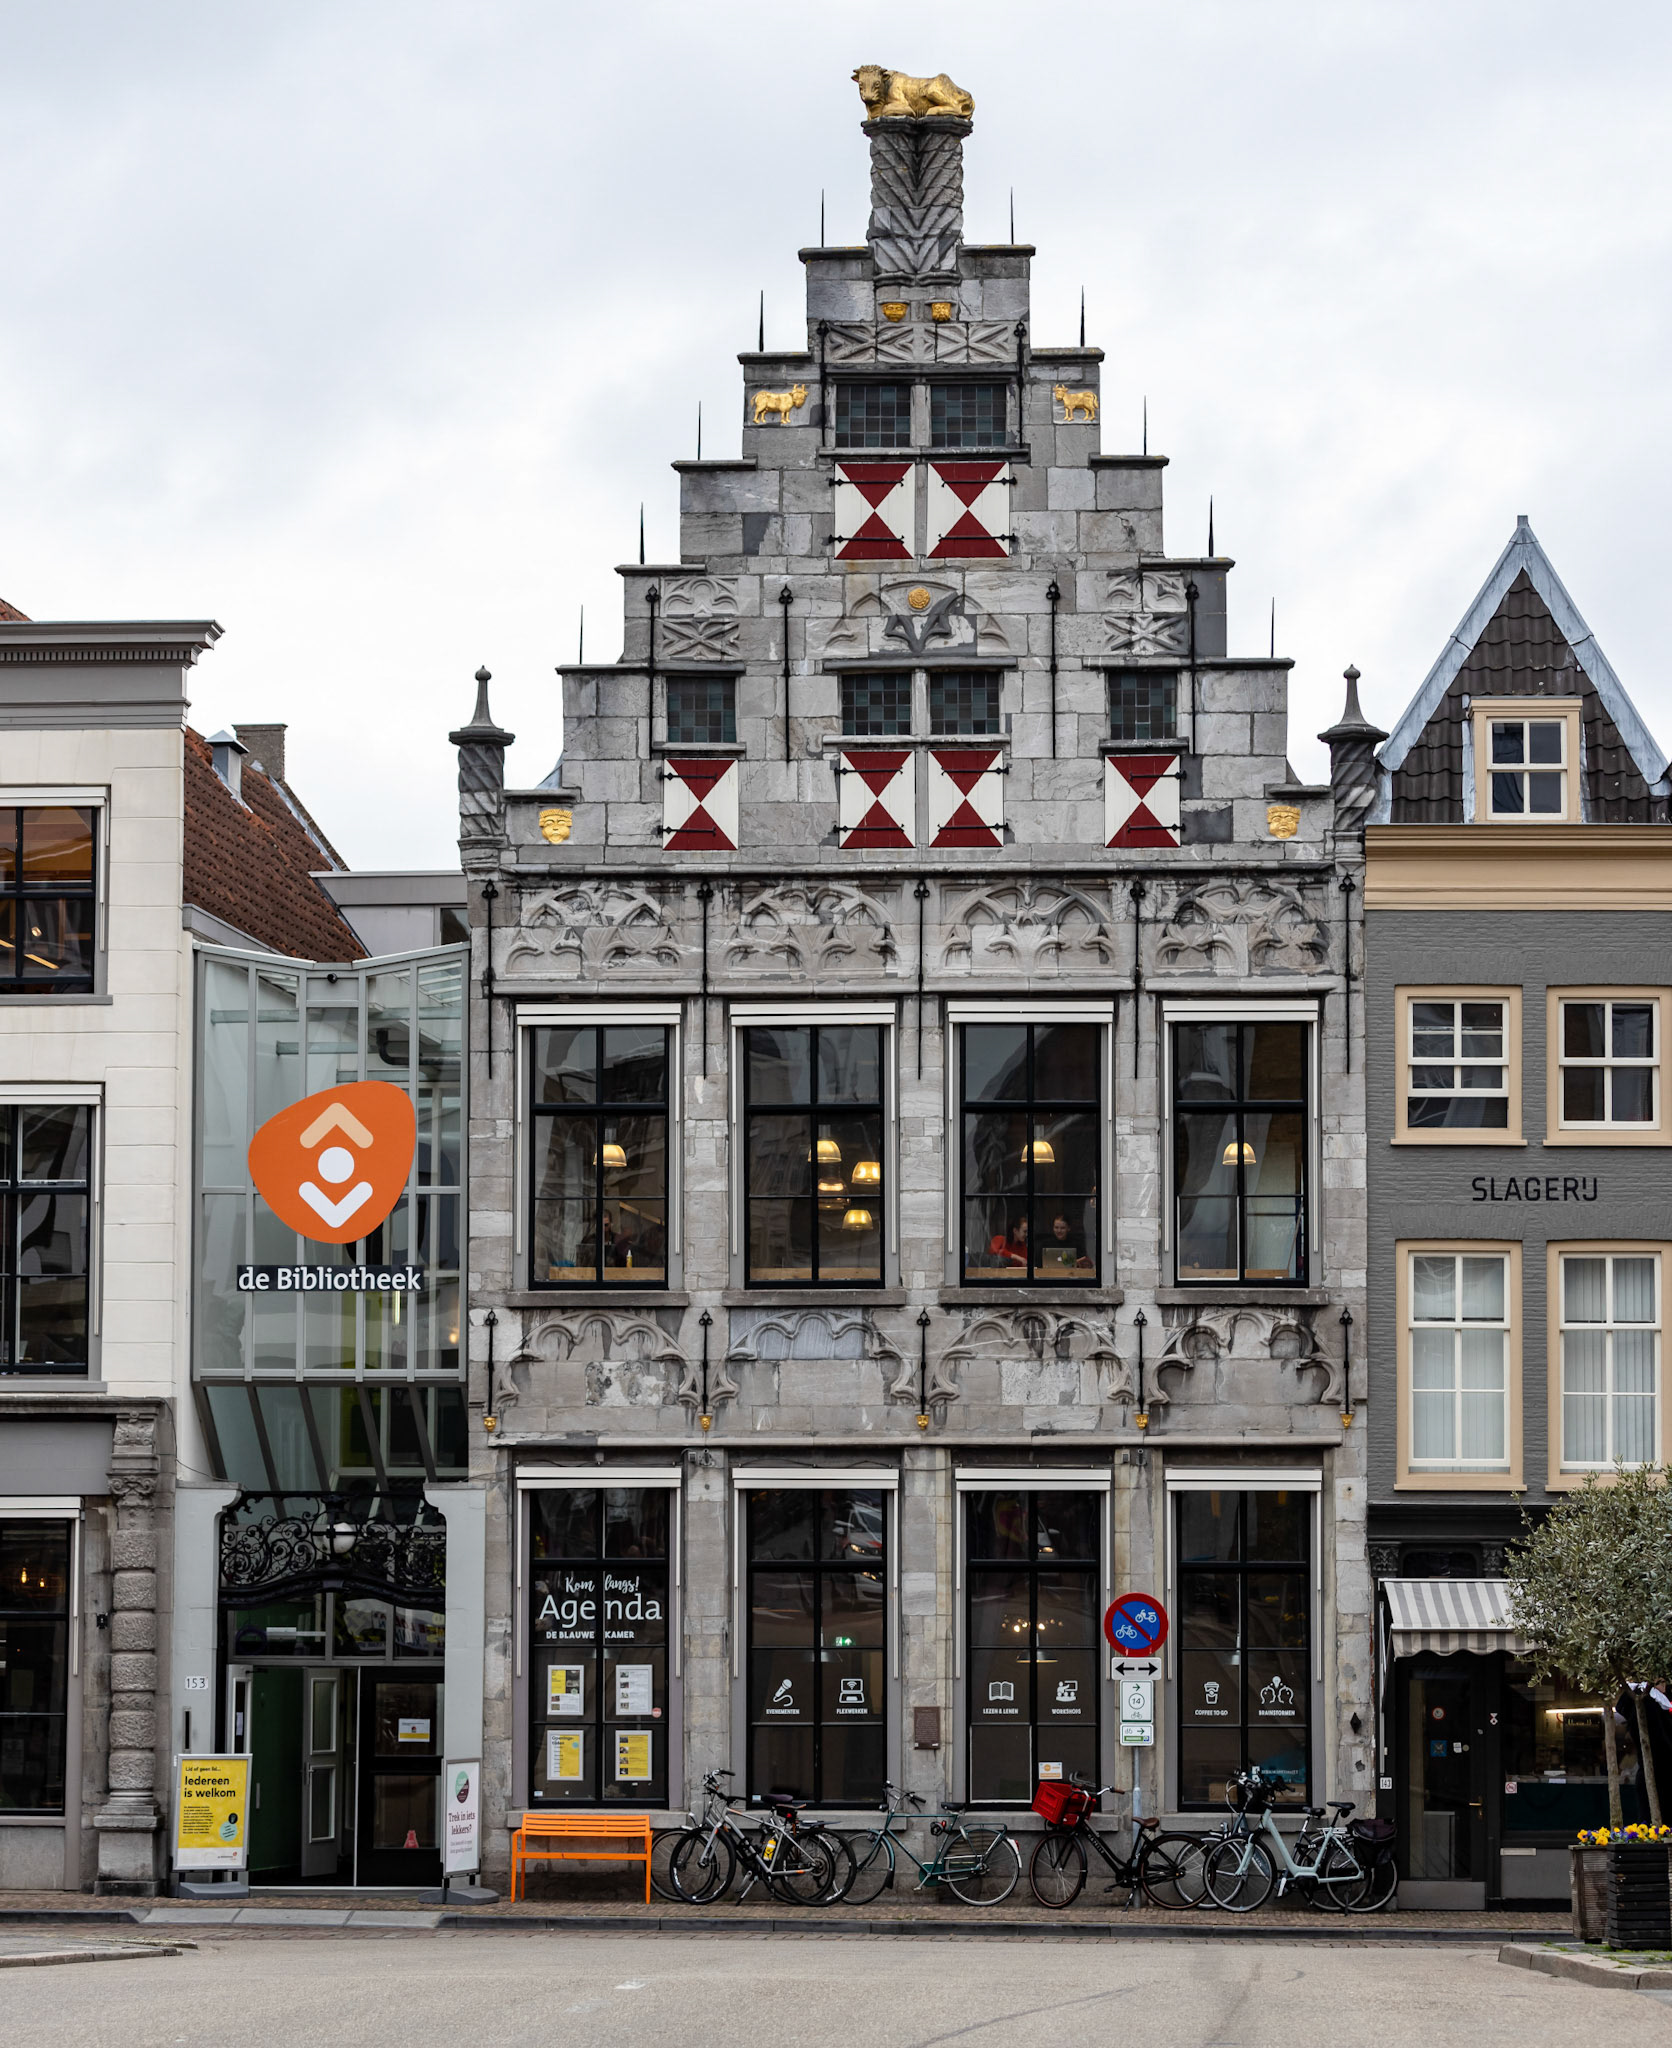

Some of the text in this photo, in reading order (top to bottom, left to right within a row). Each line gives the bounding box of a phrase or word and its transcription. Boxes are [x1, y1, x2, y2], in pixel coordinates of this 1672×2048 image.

[1471, 1177, 1598, 1201] SLAGERIJ
[238, 1266, 421, 1290] de Bibliotheek
[565, 1574, 640, 1594] Kom langs!
[539, 1592, 663, 1629] Agenda
[546, 1630, 635, 1639] DE BLAUWE KAMER
[186, 1677, 206, 1689] 153
[184, 1775, 230, 1786] Iedereen
[1381, 1778, 1391, 1788] 143
[184, 1787, 236, 1798] is welkom
[448, 1810, 476, 1822] Trek in iets
[451, 1823, 472, 1835] lekkers?
